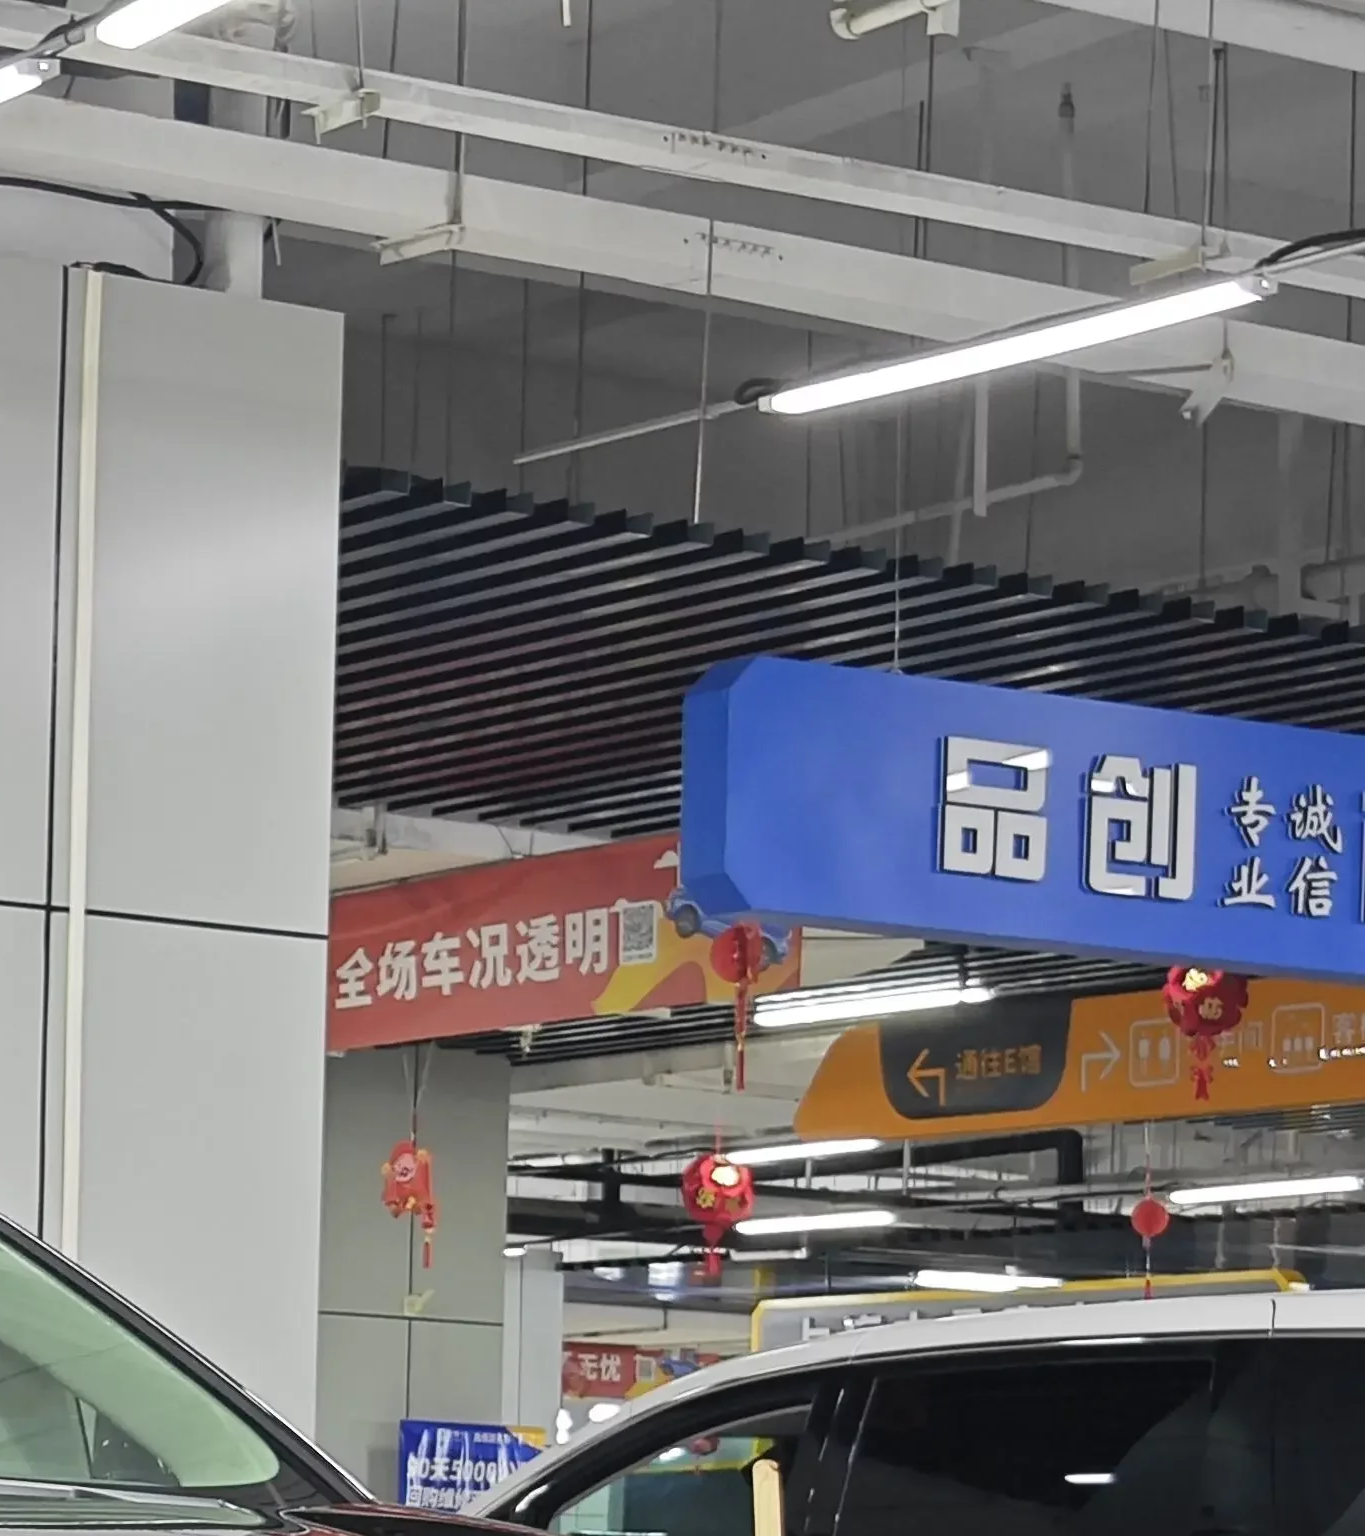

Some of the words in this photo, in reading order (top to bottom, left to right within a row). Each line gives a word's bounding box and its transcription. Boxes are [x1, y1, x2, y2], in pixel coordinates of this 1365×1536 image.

[939, 735, 1197, 901] 品创
[334, 906, 611, 1010] 全场车况透明
